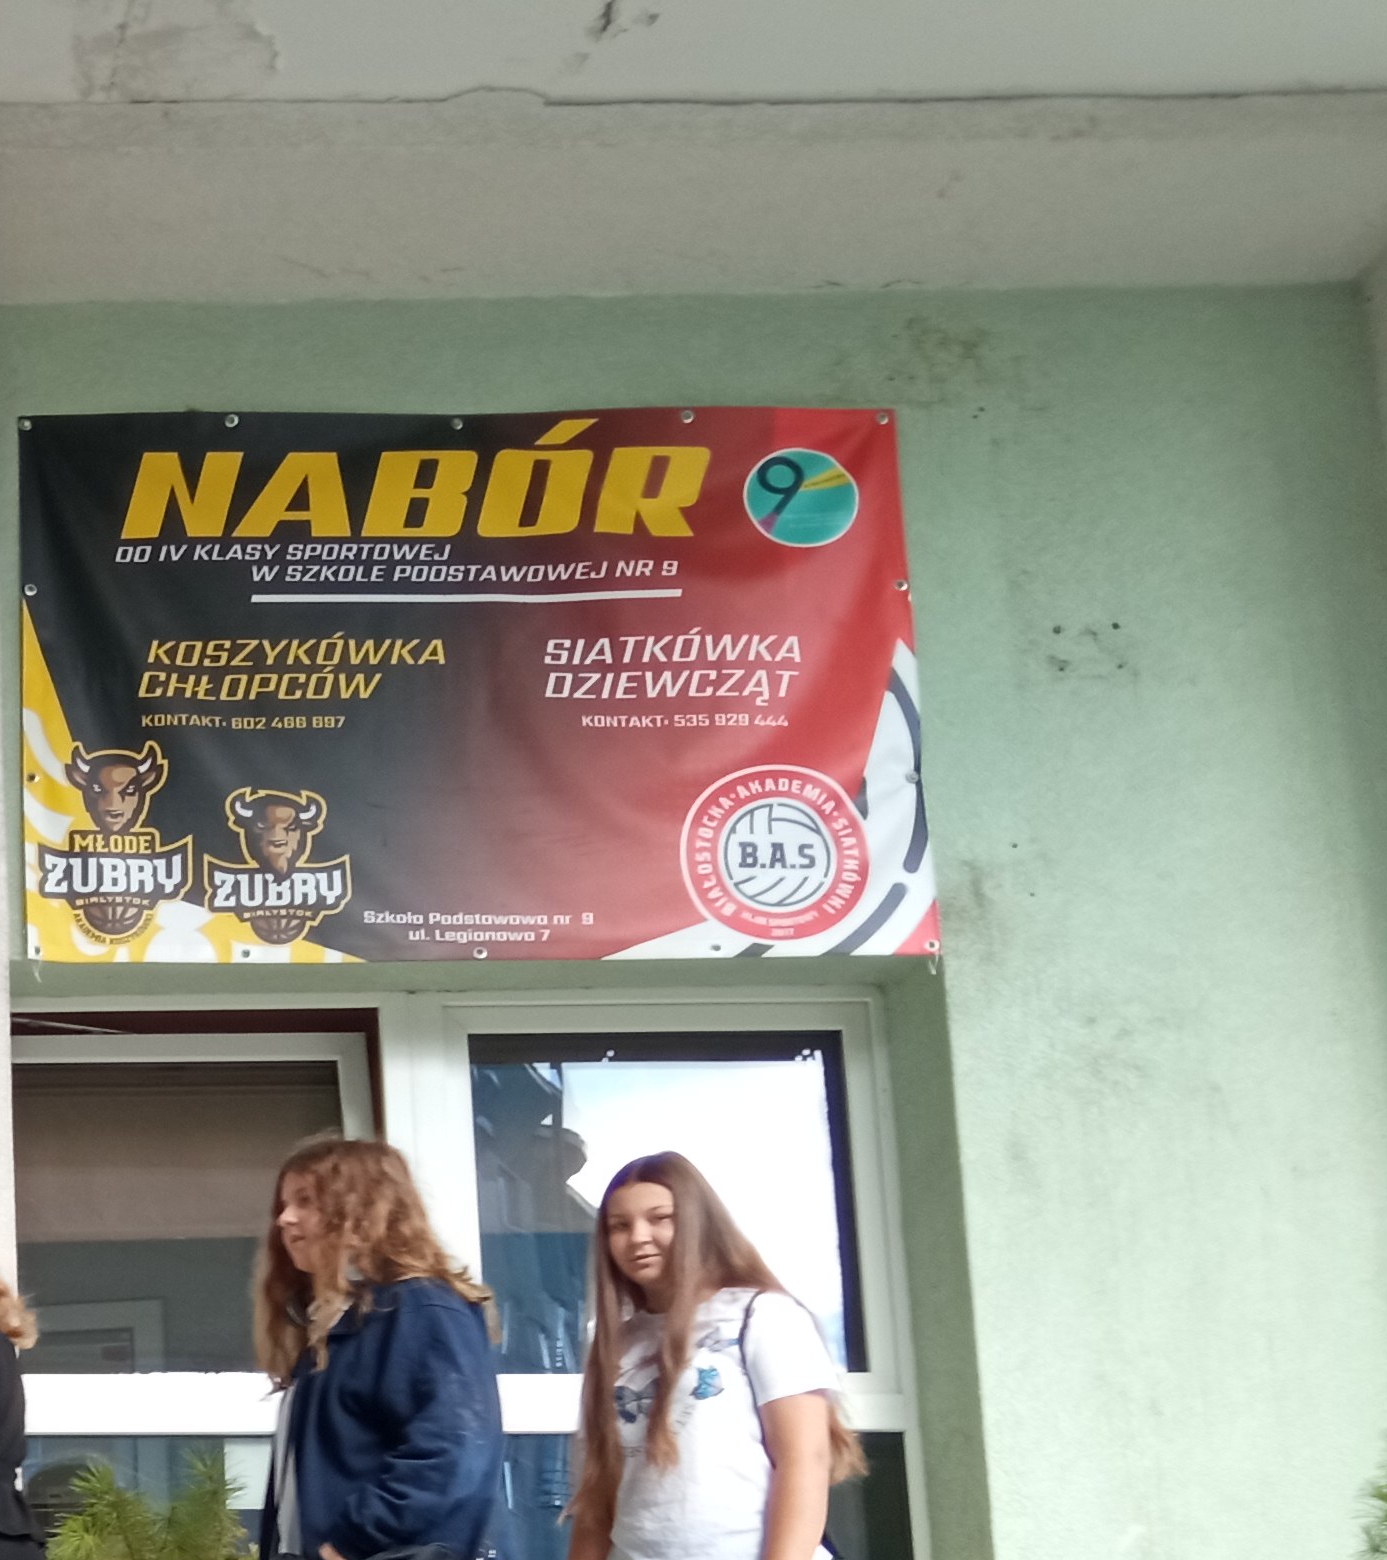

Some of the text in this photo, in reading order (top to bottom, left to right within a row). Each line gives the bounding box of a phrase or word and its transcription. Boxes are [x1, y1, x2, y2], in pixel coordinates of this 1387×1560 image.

[121, 418, 711, 539] NABÓR
[115, 543, 451, 563] DO IV KLASY SPORTOWEJ
[251, 560, 679, 582] W SZKOLE PODSTAWOWEJ NR 9
[148, 632, 446, 667] KOSZYKÓWKA
[544, 627, 802, 665] SIATKÓWKA
[138, 667, 382, 701] CHŁOPCÓW
[545, 669, 800, 706] DZIEWCZĄT
[231, 717, 266, 730] 602
[674, 714, 709, 726] 535
[736, 778, 836, 815] AKADEMIA
[73, 834, 152, 853] MŁODE
[363, 911, 594, 926] Szkoła Podstawowa nr 9
[409, 929, 551, 944] ul. Legionowa 7
